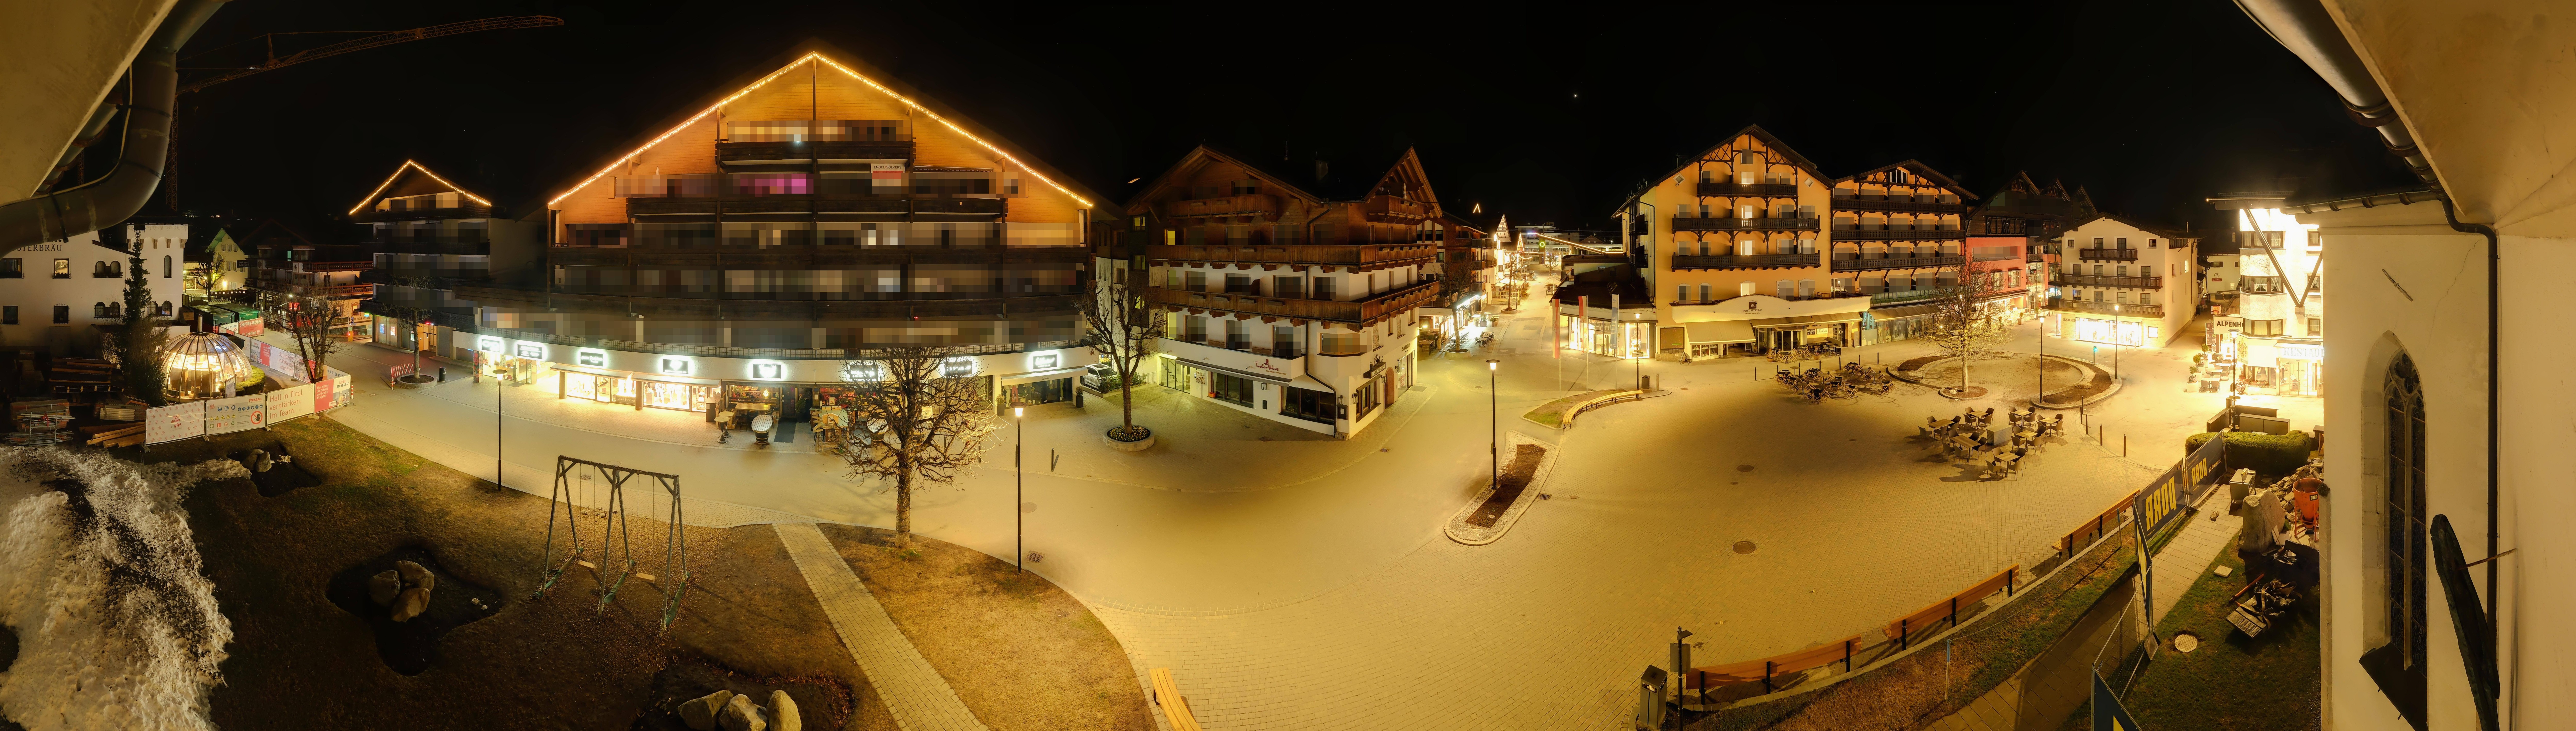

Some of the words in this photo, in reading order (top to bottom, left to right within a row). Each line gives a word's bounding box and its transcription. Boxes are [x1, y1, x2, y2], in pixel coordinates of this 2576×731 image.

[1402, 343, 1410, 351] SAILER
[1371, 364, 1385, 377] RESTAURANT
[270, 394, 281, 402] Hall
[290, 389, 303, 397] Tirol
[270, 400, 301, 410] verstärken.
